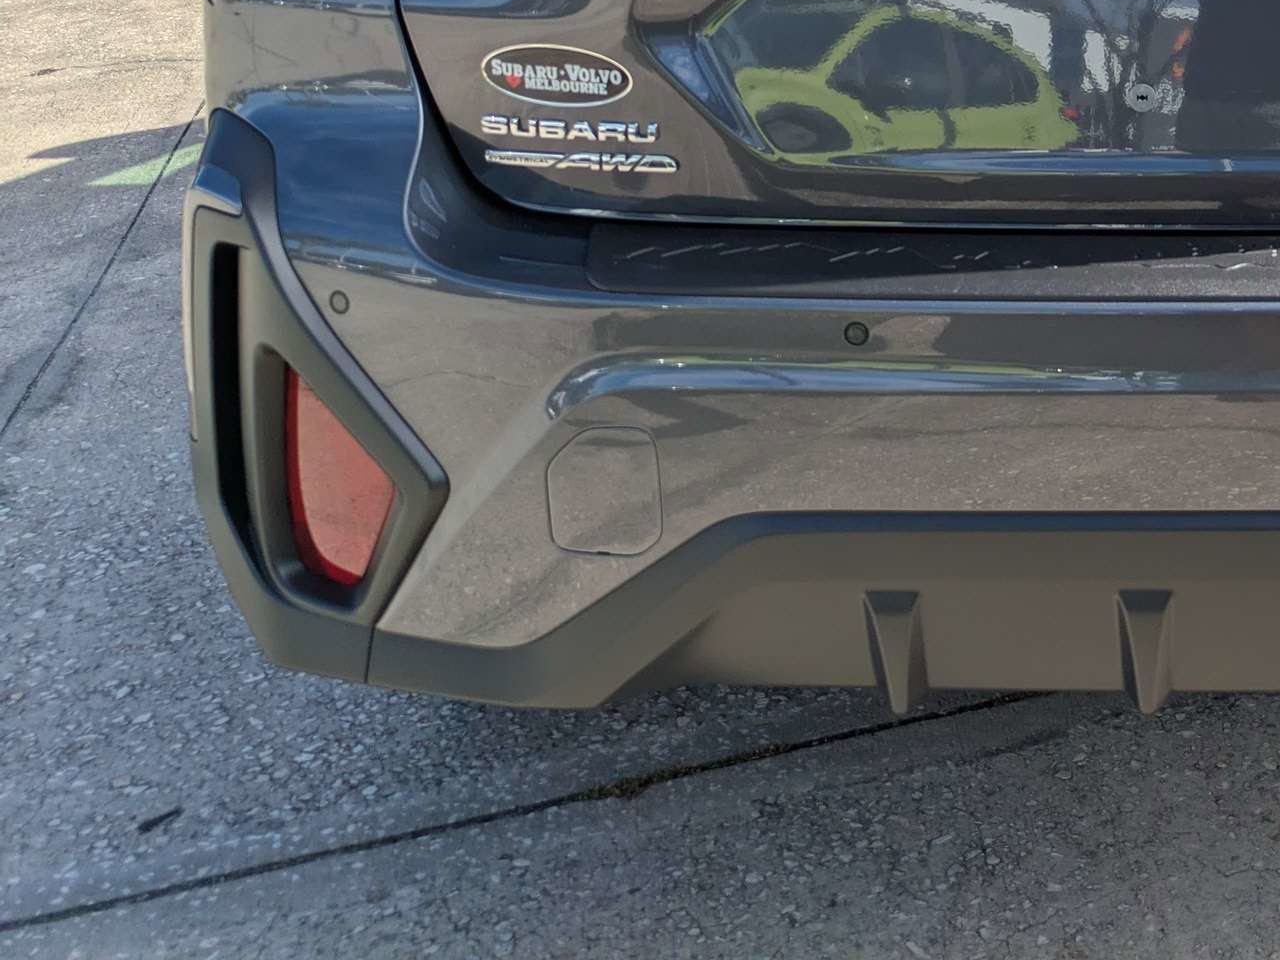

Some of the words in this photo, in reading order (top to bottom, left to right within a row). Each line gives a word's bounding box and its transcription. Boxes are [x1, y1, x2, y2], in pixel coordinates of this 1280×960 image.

[491, 58, 558, 80] SUBARU
[564, 63, 623, 85] VOLVO
[524, 77, 608, 95] MELBOURNE
[480, 114, 659, 144] SUBARU
[554, 151, 680, 174] AWD
